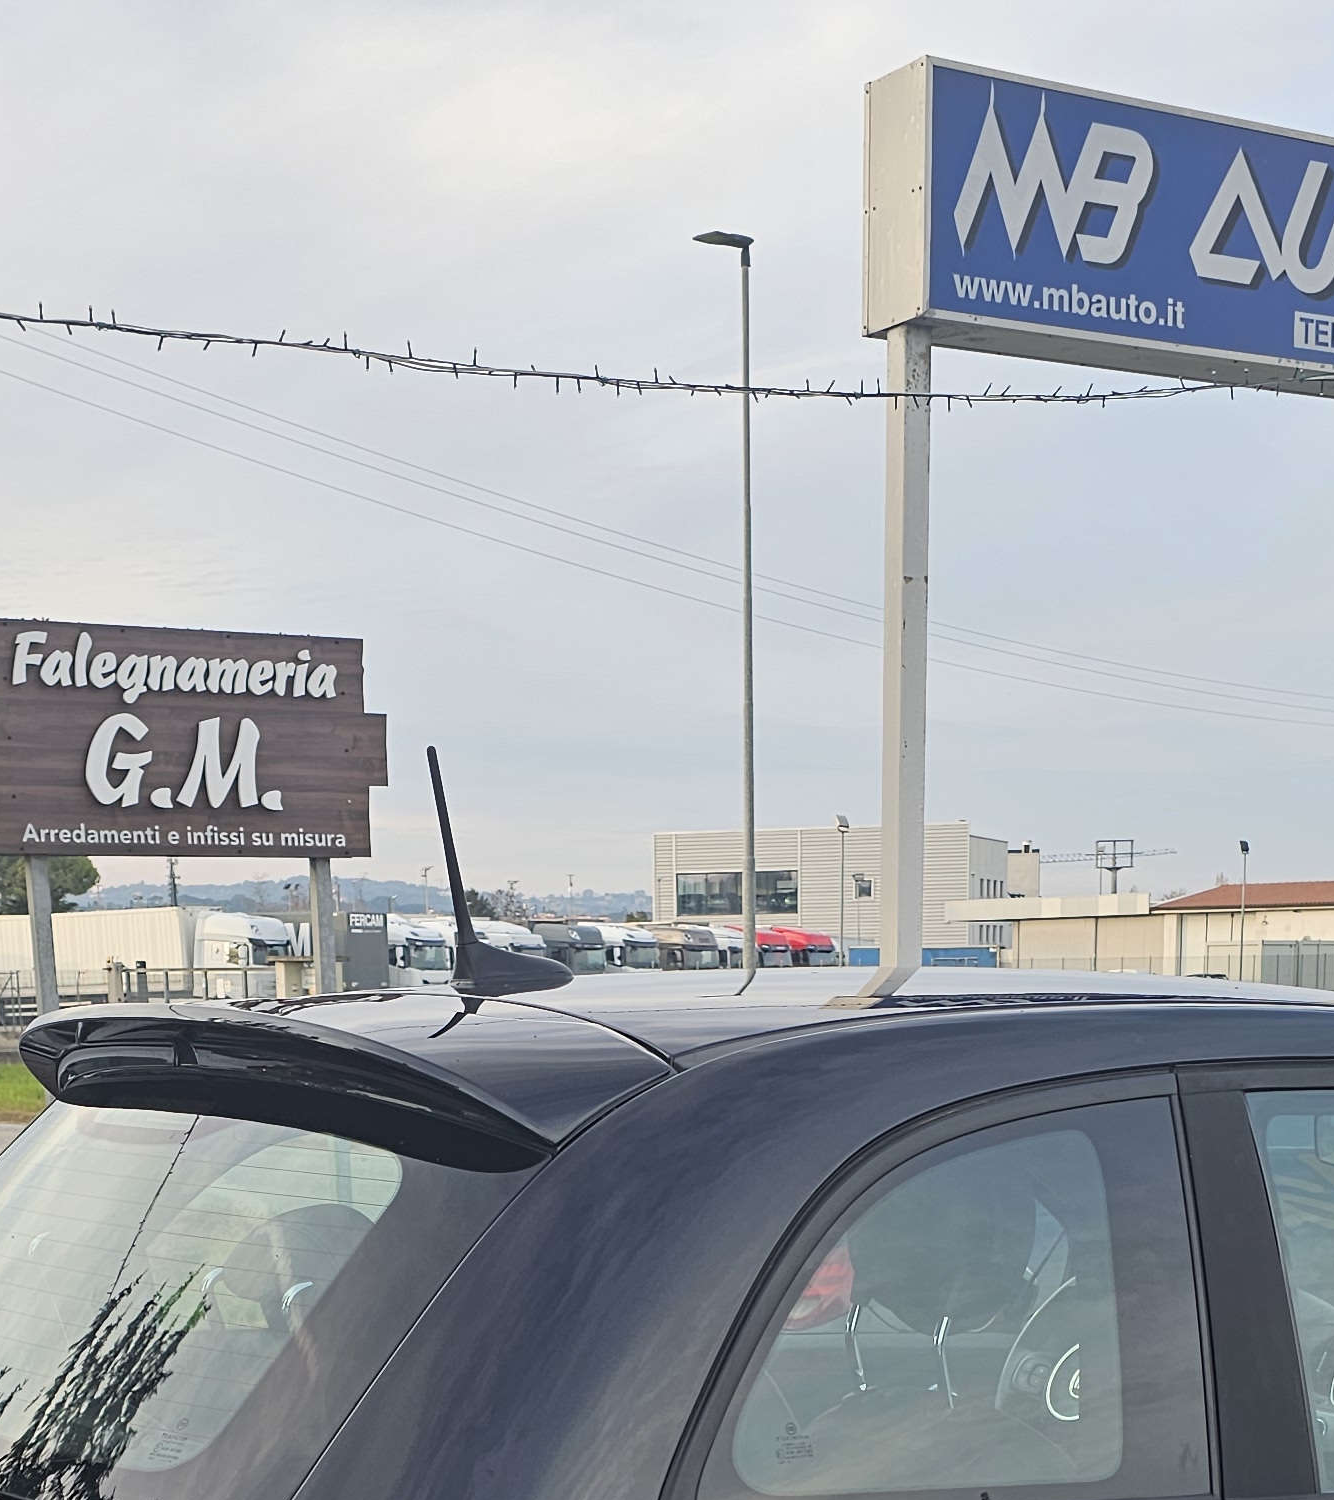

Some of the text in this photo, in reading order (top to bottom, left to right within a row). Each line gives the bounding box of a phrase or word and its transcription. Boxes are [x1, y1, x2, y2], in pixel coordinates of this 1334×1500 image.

[953, 80, 1155, 266] MB
[953, 272, 1185, 329] www.mbauto.it
[12, 629, 337, 704] Falegnameria
[85, 712, 284, 811] G.M.
[22, 823, 347, 848] Arredamenti e infissi su misura
[349, 913, 384, 927] FERCAM
